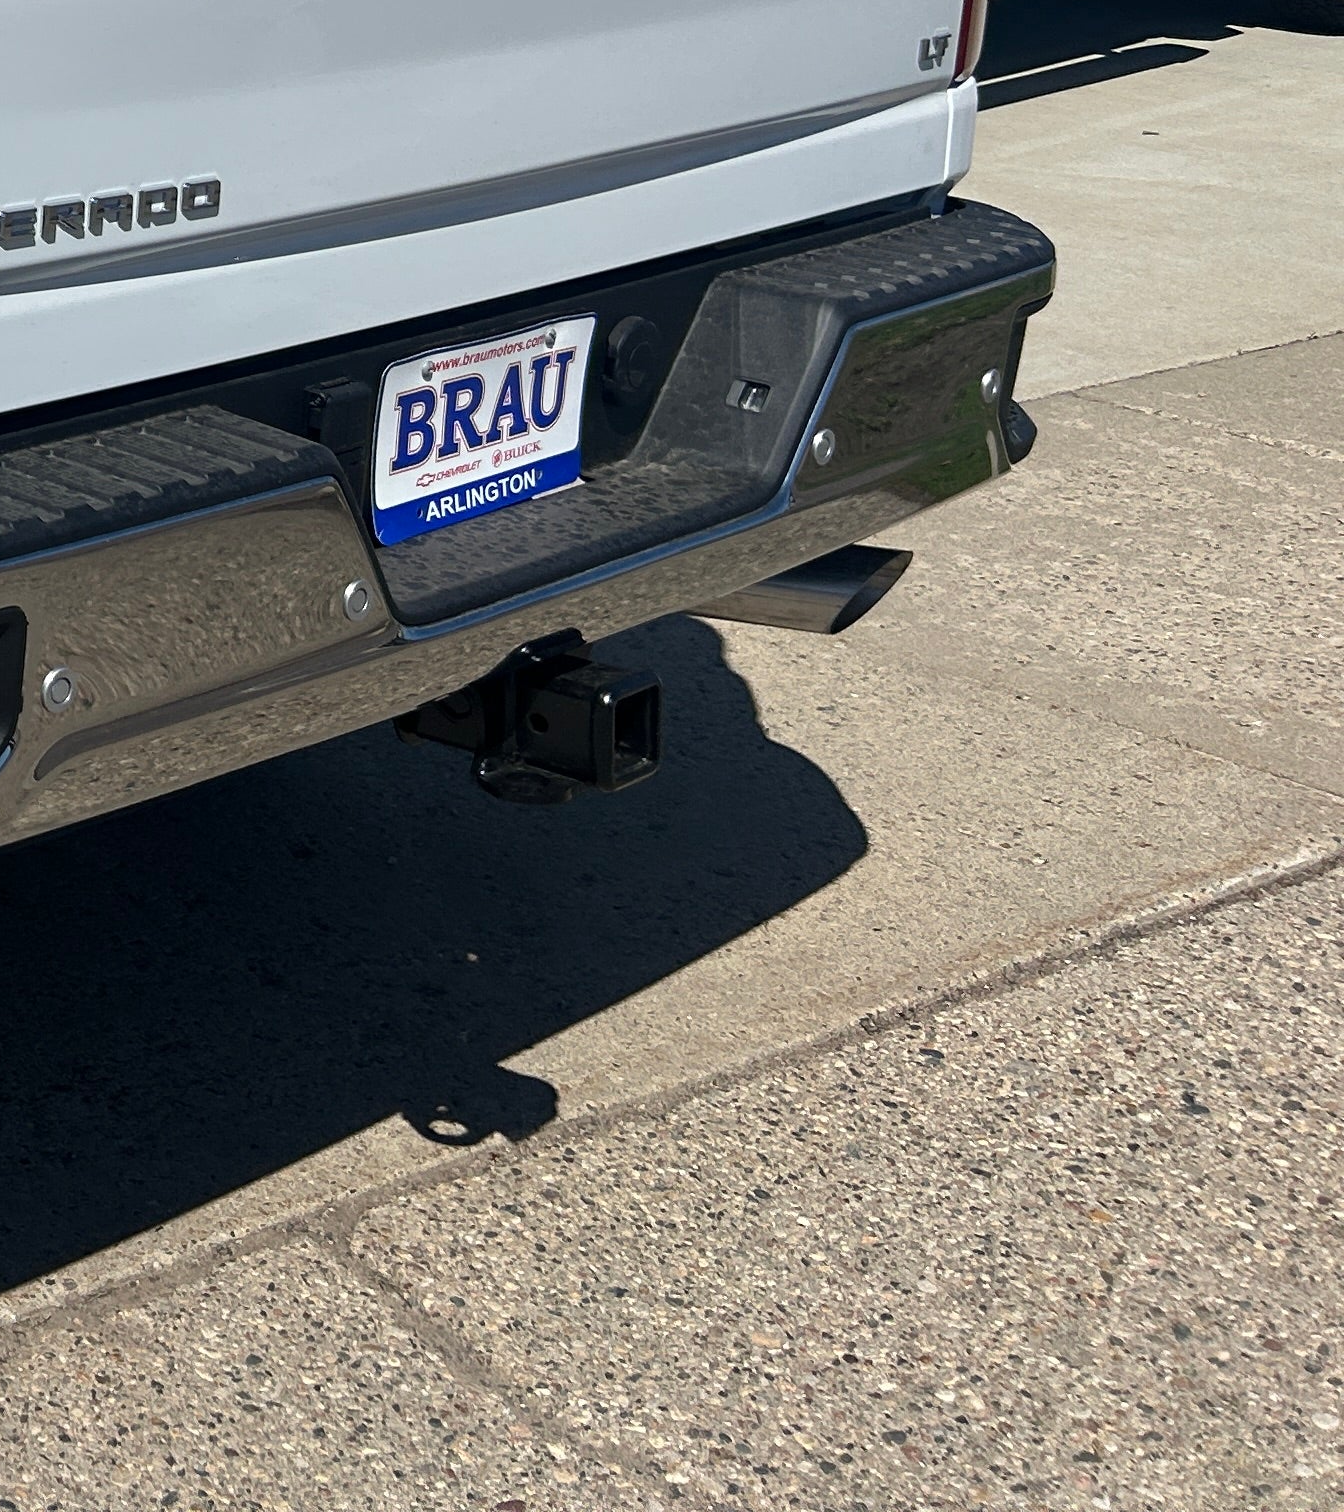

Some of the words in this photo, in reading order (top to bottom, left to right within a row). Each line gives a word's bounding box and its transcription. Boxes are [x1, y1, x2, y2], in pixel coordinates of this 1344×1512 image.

[916, 31, 952, 72] LT
[430, 334, 546, 373] www.braumotors.com
[389, 346, 577, 476] BRAU
[435, 459, 482, 481] CHEVROLET
[503, 440, 542, 463] BUICK
[425, 468, 537, 522] ARLINGTON
